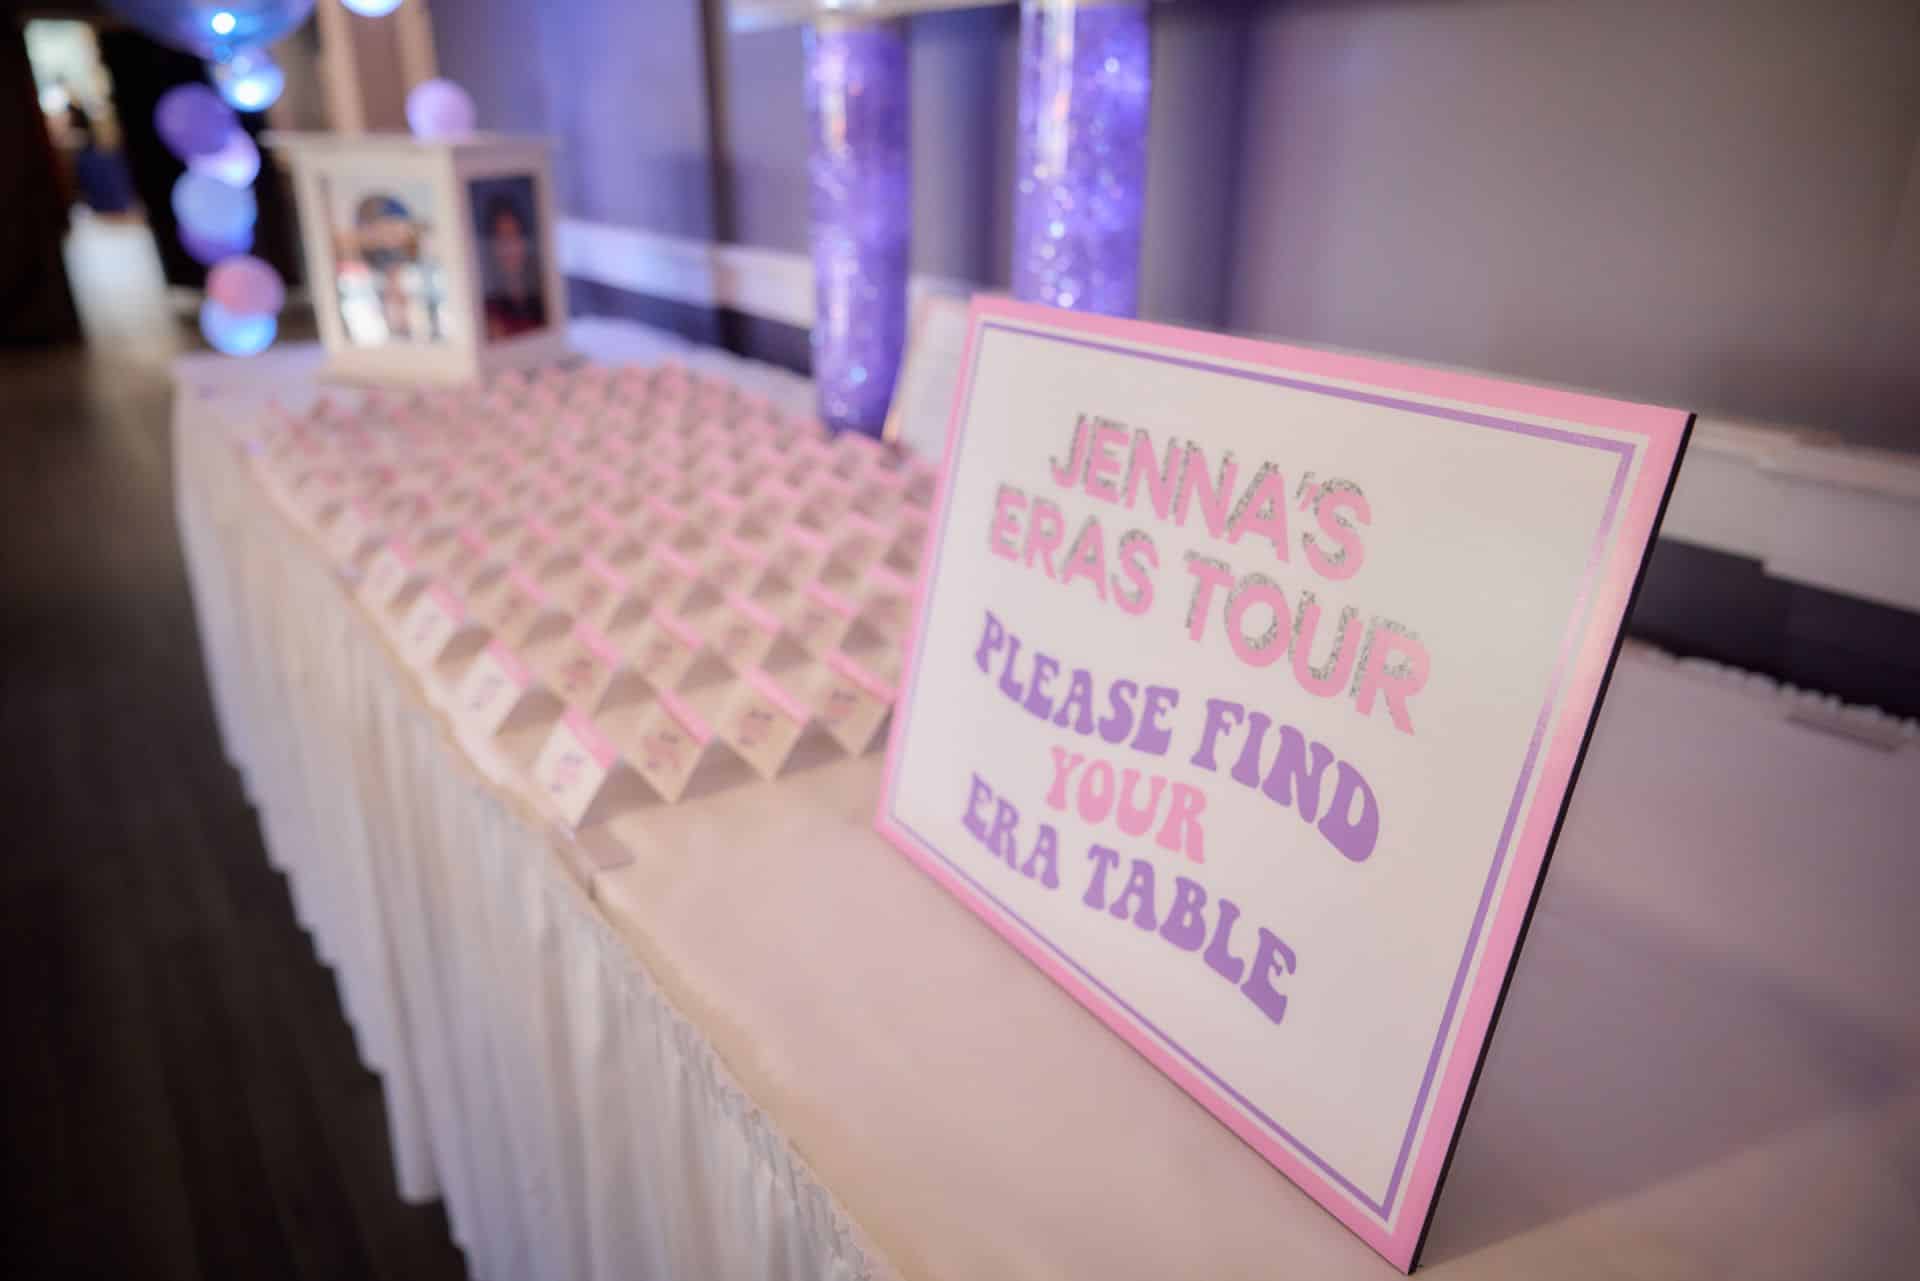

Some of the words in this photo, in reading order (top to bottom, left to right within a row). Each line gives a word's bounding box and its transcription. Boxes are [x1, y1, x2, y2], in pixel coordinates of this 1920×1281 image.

[988, 481, 1160, 616] ERAS
[1184, 549, 1431, 736] TOUR
[1050, 413, 1371, 581] JENNA'S
[974, 609, 1179, 756] PLEASE
[1190, 697, 1379, 863] FIND
[1046, 745, 1207, 864] YOUR
[961, 771, 1060, 889] ERA
[1082, 843, 1296, 1025] TABLE
